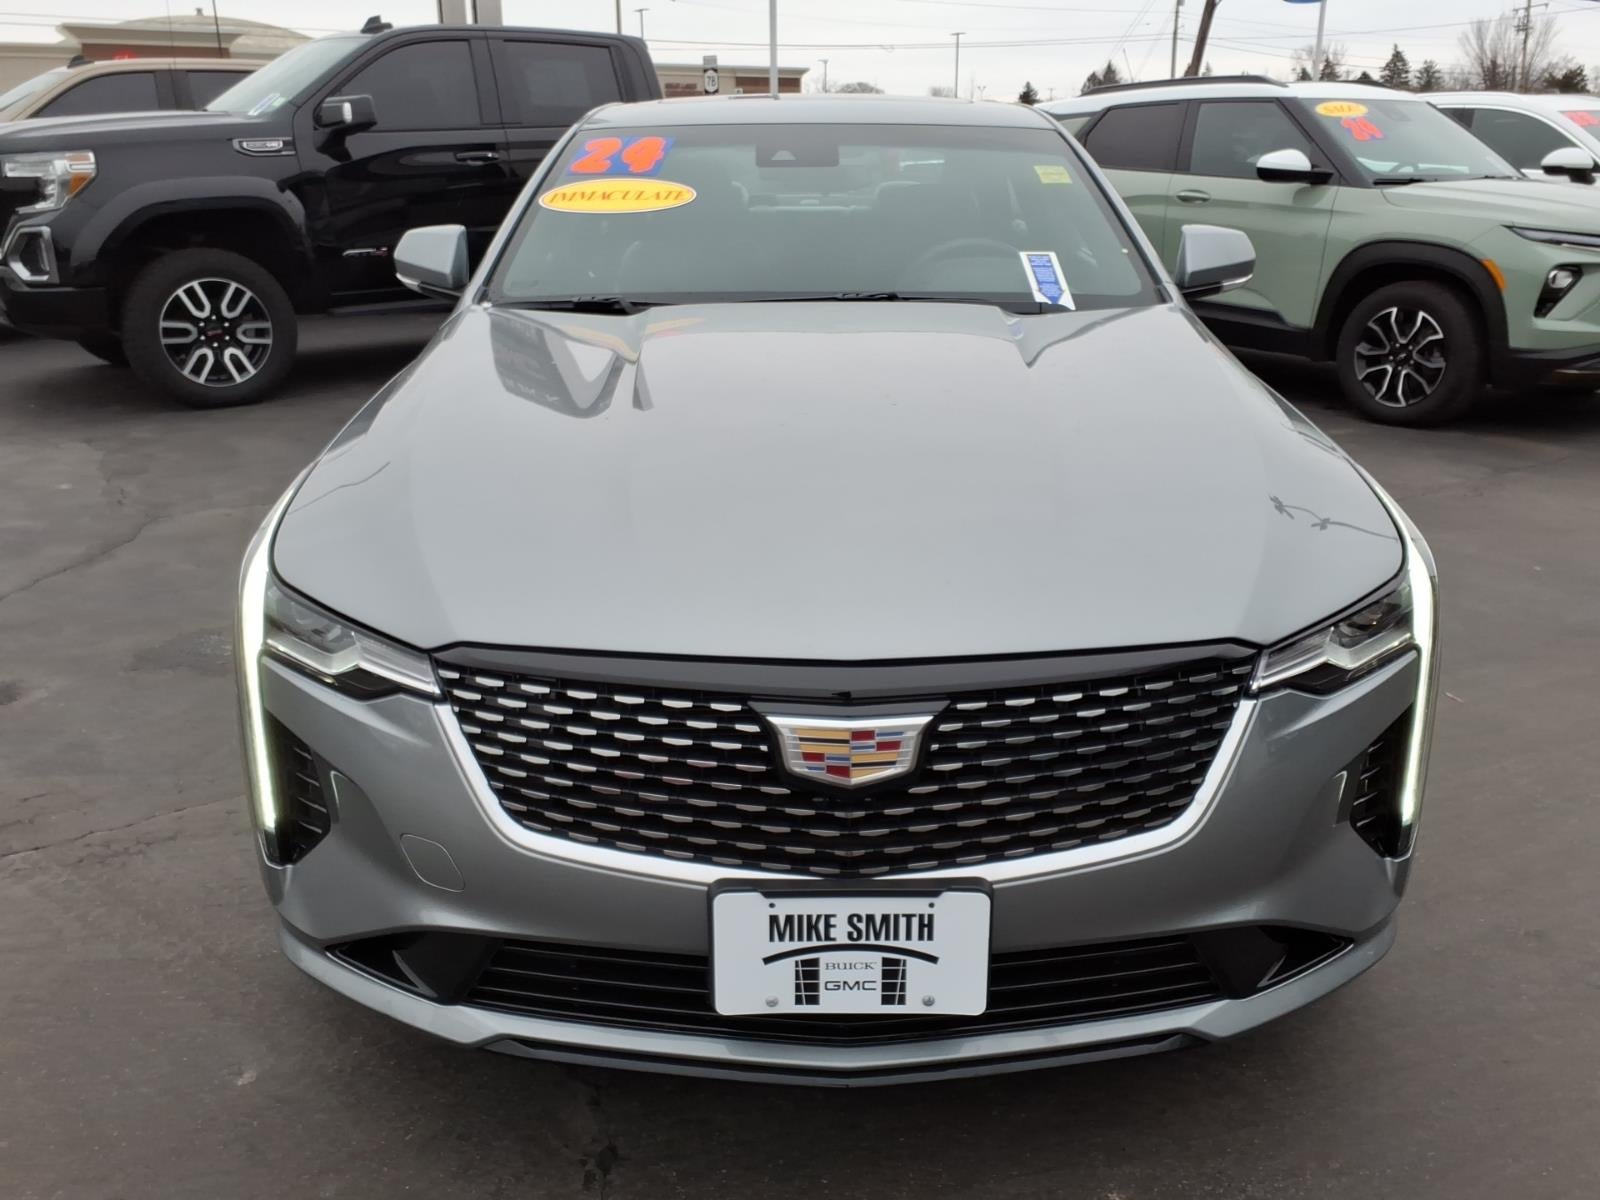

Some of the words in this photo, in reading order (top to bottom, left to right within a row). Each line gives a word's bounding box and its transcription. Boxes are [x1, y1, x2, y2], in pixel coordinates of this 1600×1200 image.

[569, 136, 666, 174] 24
[550, 189, 688, 203] IMMACULATE
[768, 914, 837, 942] MIKE
[847, 913, 935, 942] SMITH
[825, 961, 875, 971] BUICK
[824, 980, 877, 991] GMC
